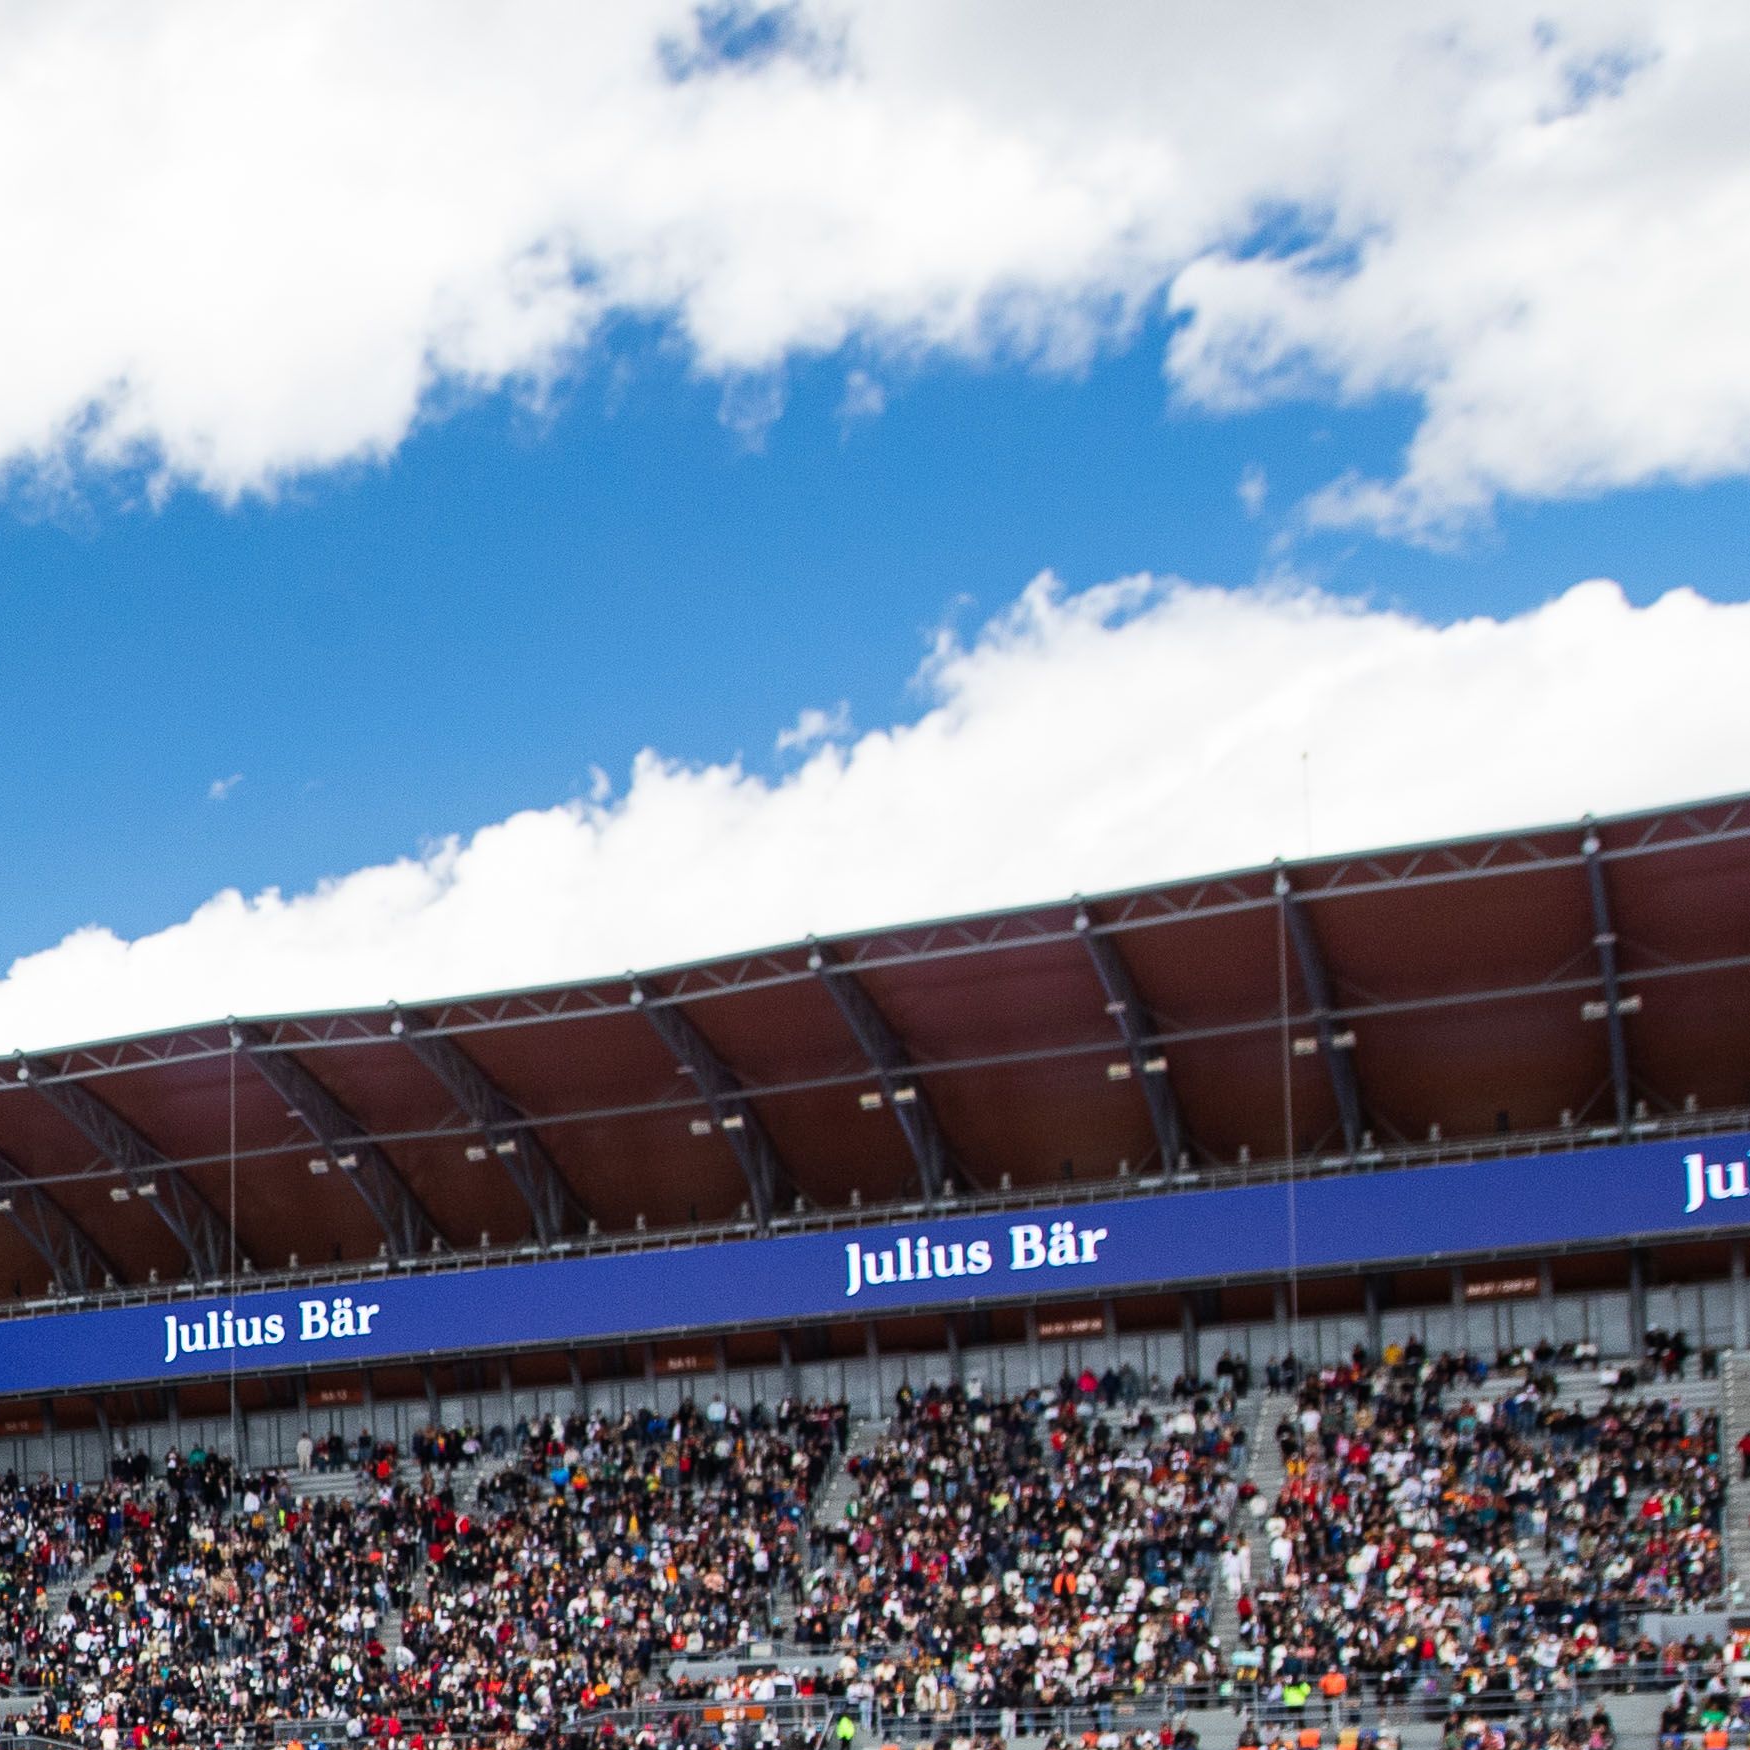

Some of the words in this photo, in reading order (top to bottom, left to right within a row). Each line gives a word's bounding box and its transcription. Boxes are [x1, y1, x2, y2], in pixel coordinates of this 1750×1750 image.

[1682, 1149, 1750, 1213] Ju
[844, 1235, 993, 1296] Julius
[1009, 1221, 1108, 1271] Bär
[163, 1309, 286, 1363] Julius
[299, 1297, 380, 1341] Bär
